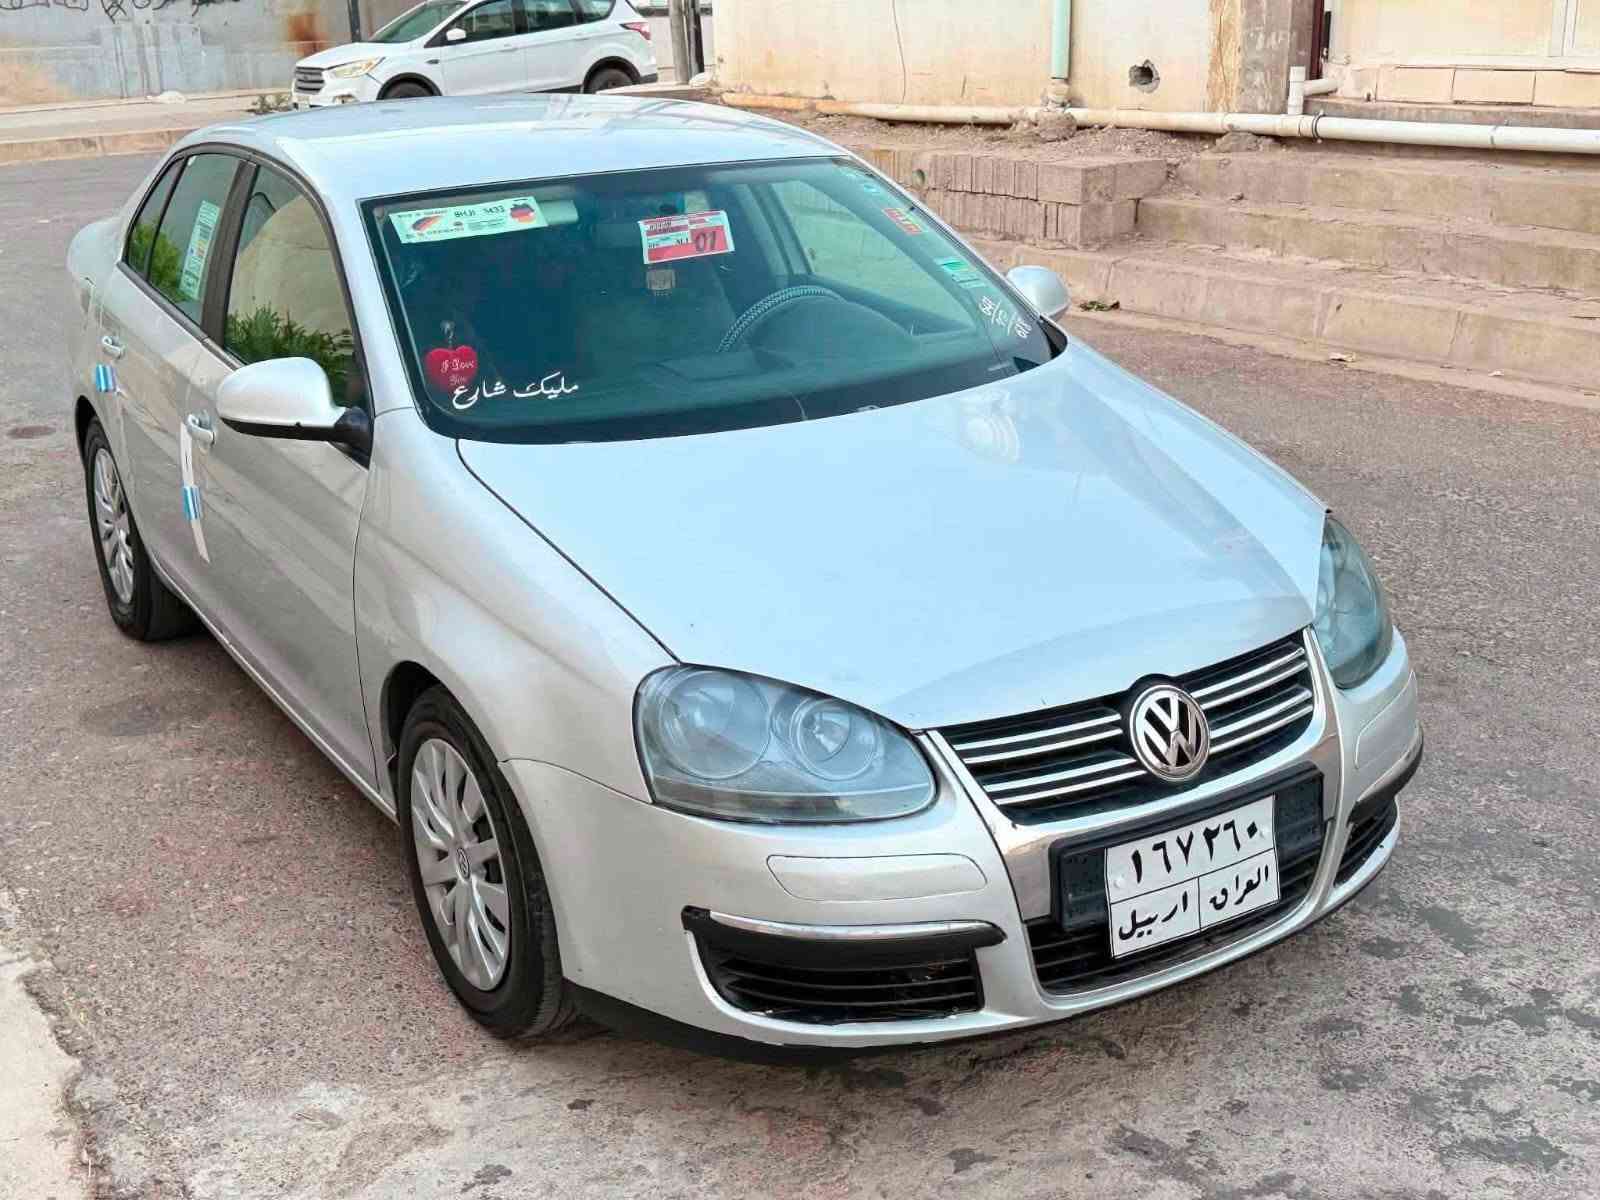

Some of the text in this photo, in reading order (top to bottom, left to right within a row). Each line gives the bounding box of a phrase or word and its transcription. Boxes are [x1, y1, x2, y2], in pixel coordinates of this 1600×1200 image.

[1131, 819, 1259, 884] ١٦٧٢٦٠
[1208, 864, 1270, 911] العراق
[1118, 890, 1189, 941] اربيل
